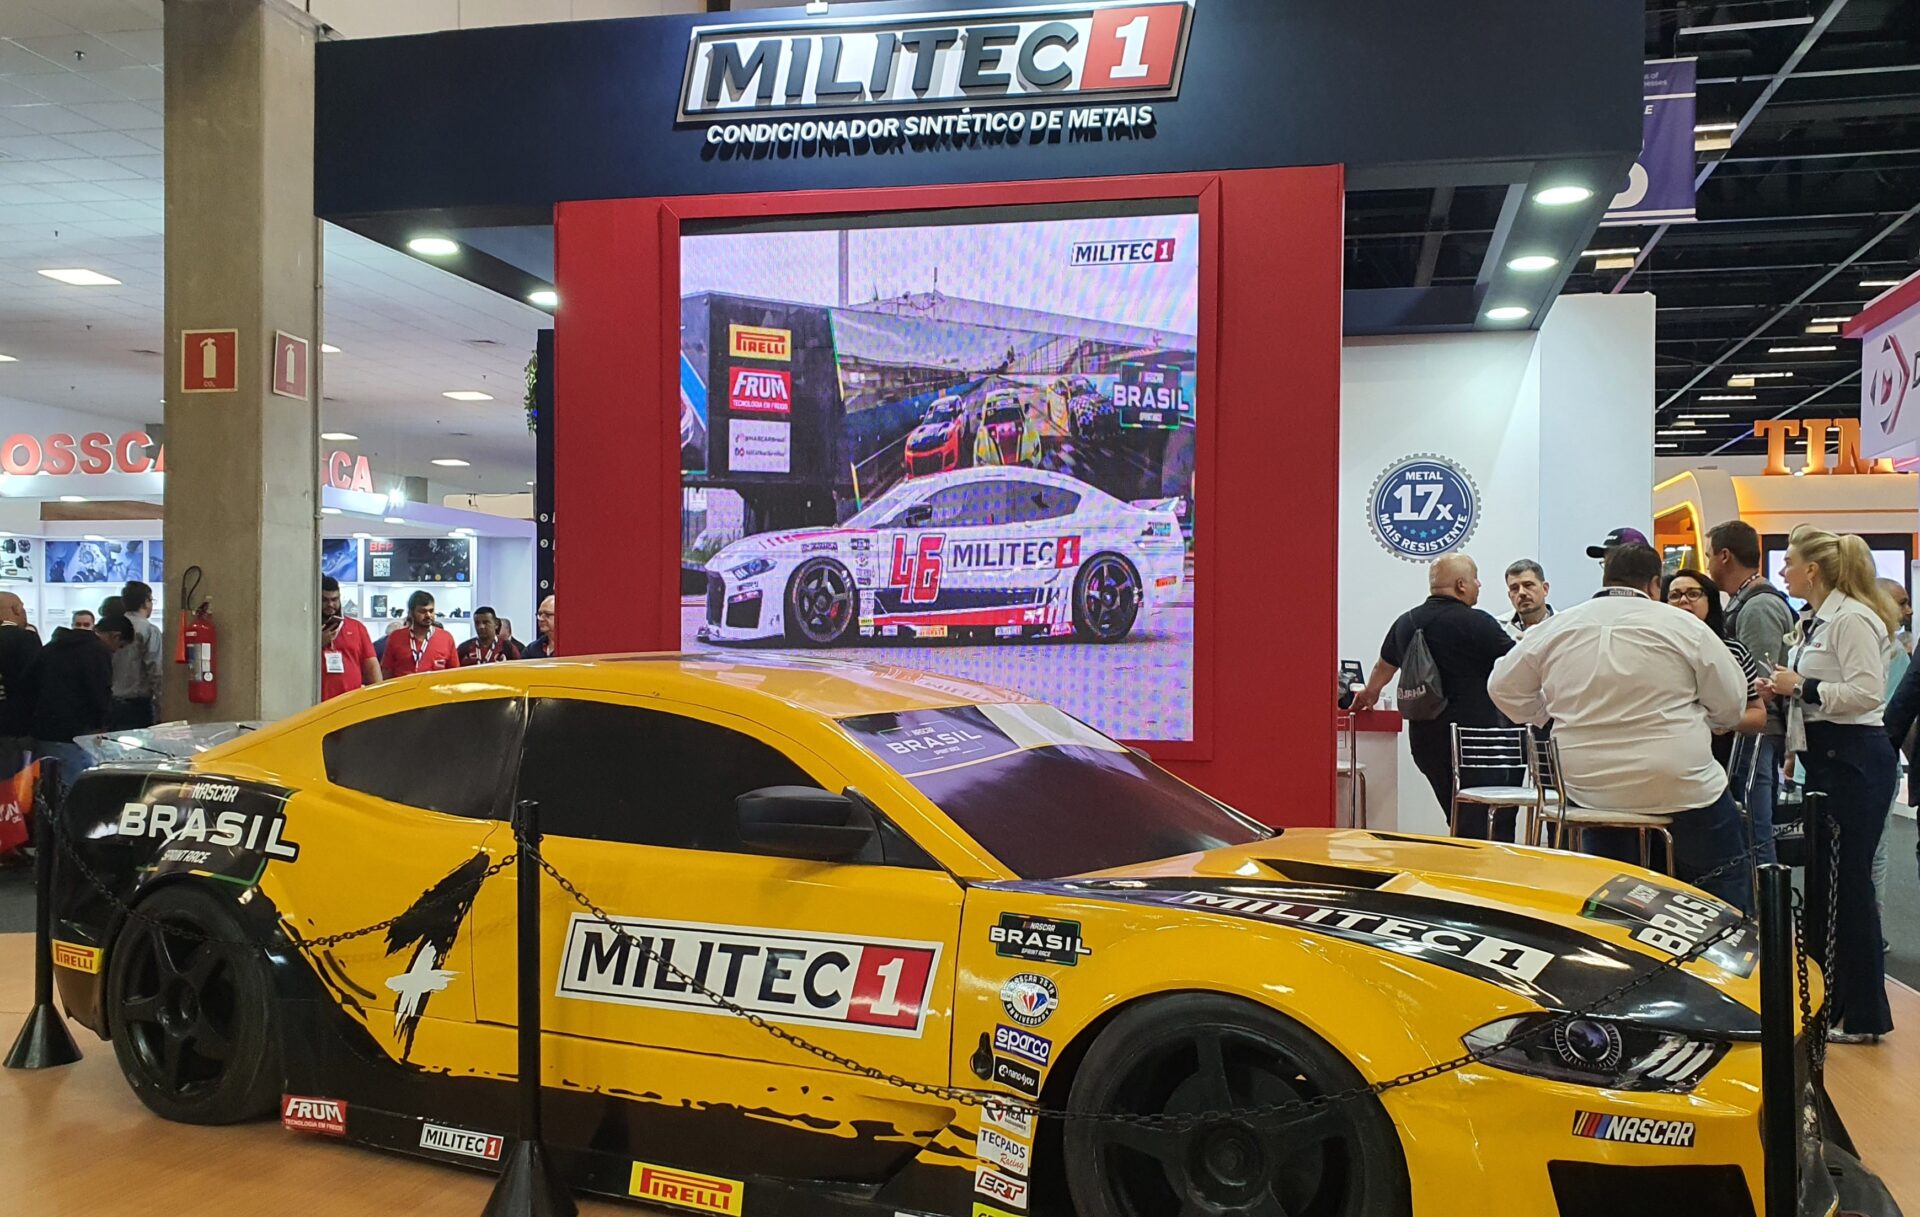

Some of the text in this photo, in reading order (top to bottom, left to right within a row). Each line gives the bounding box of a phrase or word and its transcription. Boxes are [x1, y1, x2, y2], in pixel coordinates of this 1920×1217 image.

[705, 21, 1079, 102] MILITEC
[706, 105, 1153, 145] CONDICIONADOR SINTÉTICO DE METAIS
[1075, 242, 1154, 263] MILITEC
[735, 331, 786, 355] PIRELLI
[732, 371, 789, 400] FRUM
[1113, 384, 1190, 411] BRASIL
[1, 431, 164, 476] OSSC
[1405, 471, 1444, 481] METAL
[1392, 483, 1455, 521] 17x
[369, 542, 394, 552] BFP
[1379, 513, 1468, 552] MAIS RESISTENTE
[890, 532, 946, 604] 46
[952, 540, 1055, 568] MILITEC
[886, 730, 983, 755] BRASIL
[191, 782, 240, 803] NASCAR
[118, 802, 297, 858] BRASIL
[1029, 921, 1056, 932] NASCAR
[1188, 891, 1472, 952] MILITEC
[989, 926, 1091, 955] BRASIL
[55, 942, 95, 971] PIRELLI
[576, 931, 852, 1009] MILITEC
[996, 1027, 1050, 1058] sparco
[285, 1097, 344, 1123] FRUM
[424, 1128, 485, 1153] MILITEC
[980, 1129, 1026, 1160] TECPADS
[1604, 1115, 1695, 1146] NASCAR
[999, 1152, 1025, 1172] Racing
[639, 1167, 733, 1210] PIRELLI
[979, 1171, 1024, 1200] ERT
